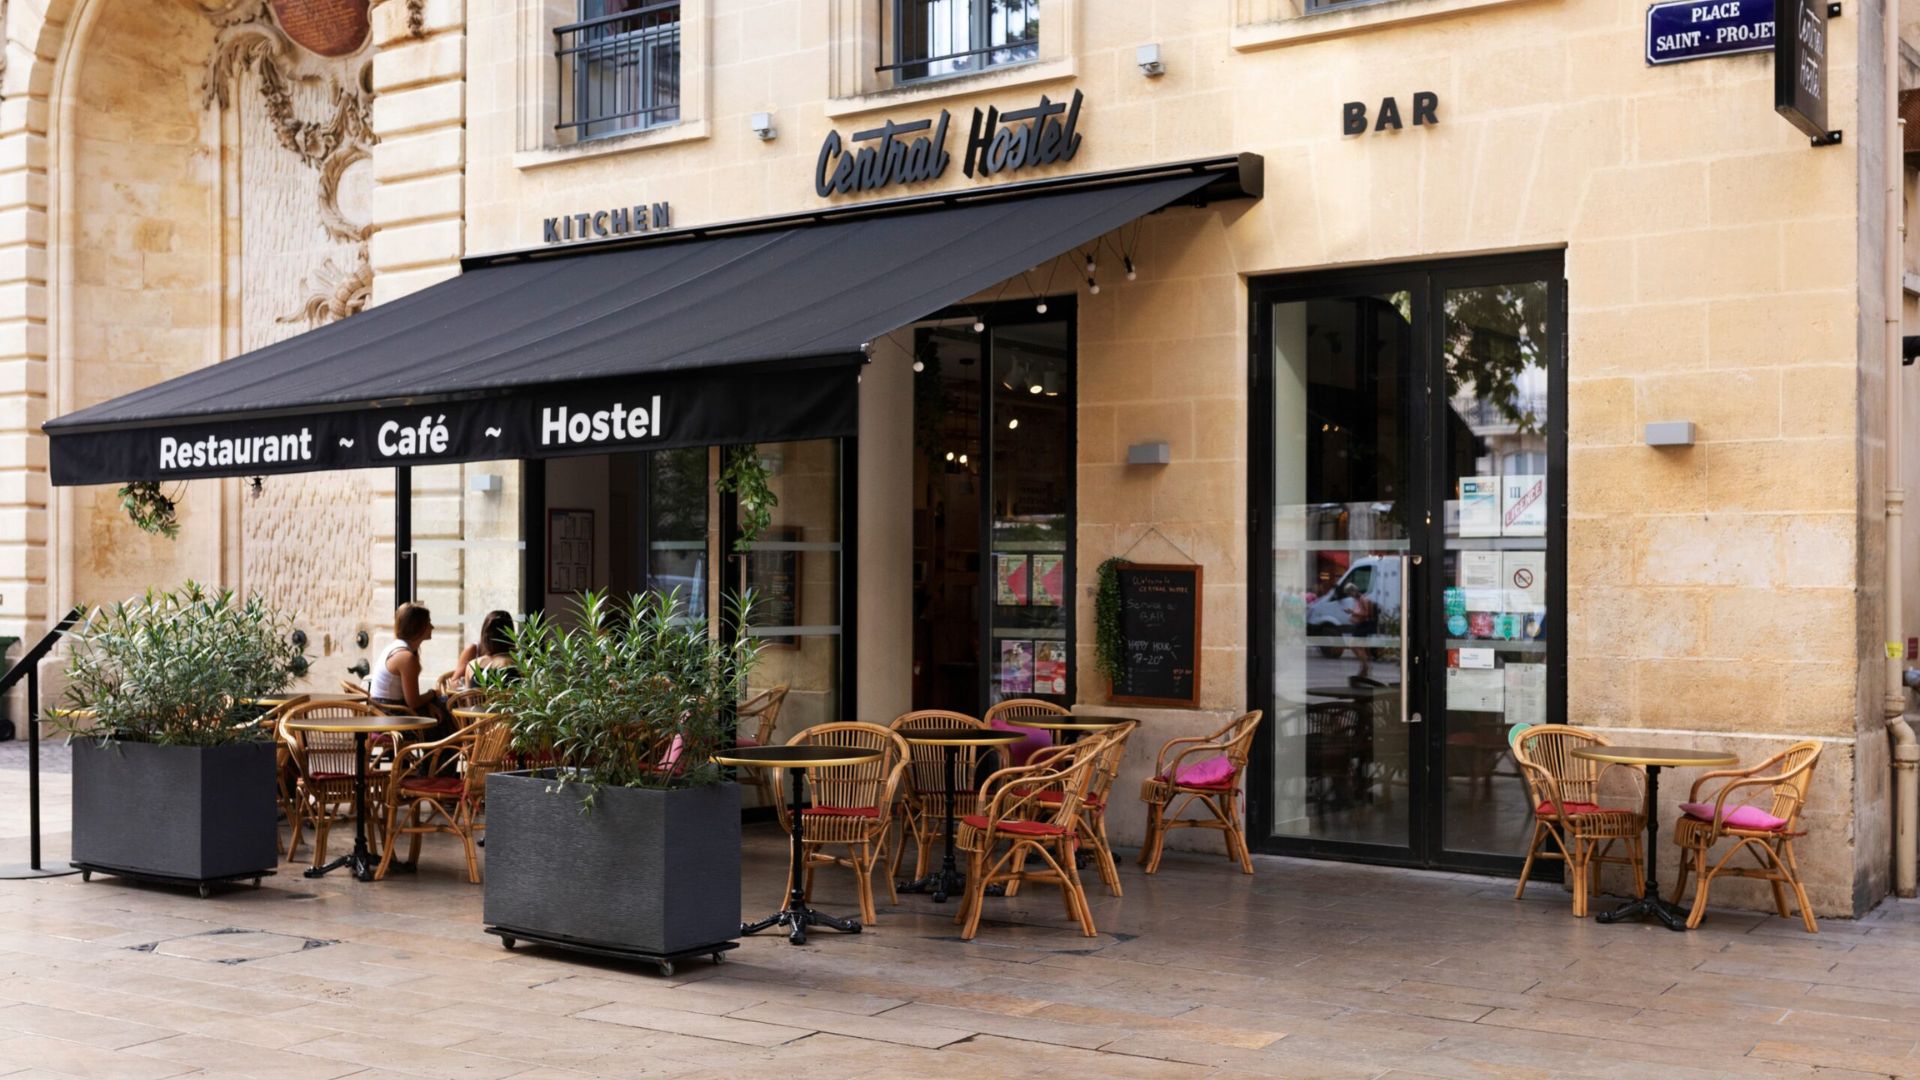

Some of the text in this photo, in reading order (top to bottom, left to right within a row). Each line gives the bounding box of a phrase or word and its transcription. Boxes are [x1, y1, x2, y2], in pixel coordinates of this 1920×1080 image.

[1691, 2, 1740, 22] PLACE
[1656, 31, 1701, 51] SAINT
[1716, 21, 1775, 43] PROJET
[1343, 91, 1439, 136] BAR
[815, 88, 1084, 198] Central Hostel
[543, 201, 670, 243] KITCHEN
[159, 427, 312, 469] Restaurant
[377, 414, 449, 457] Café
[541, 395, 661, 445] Hostel
